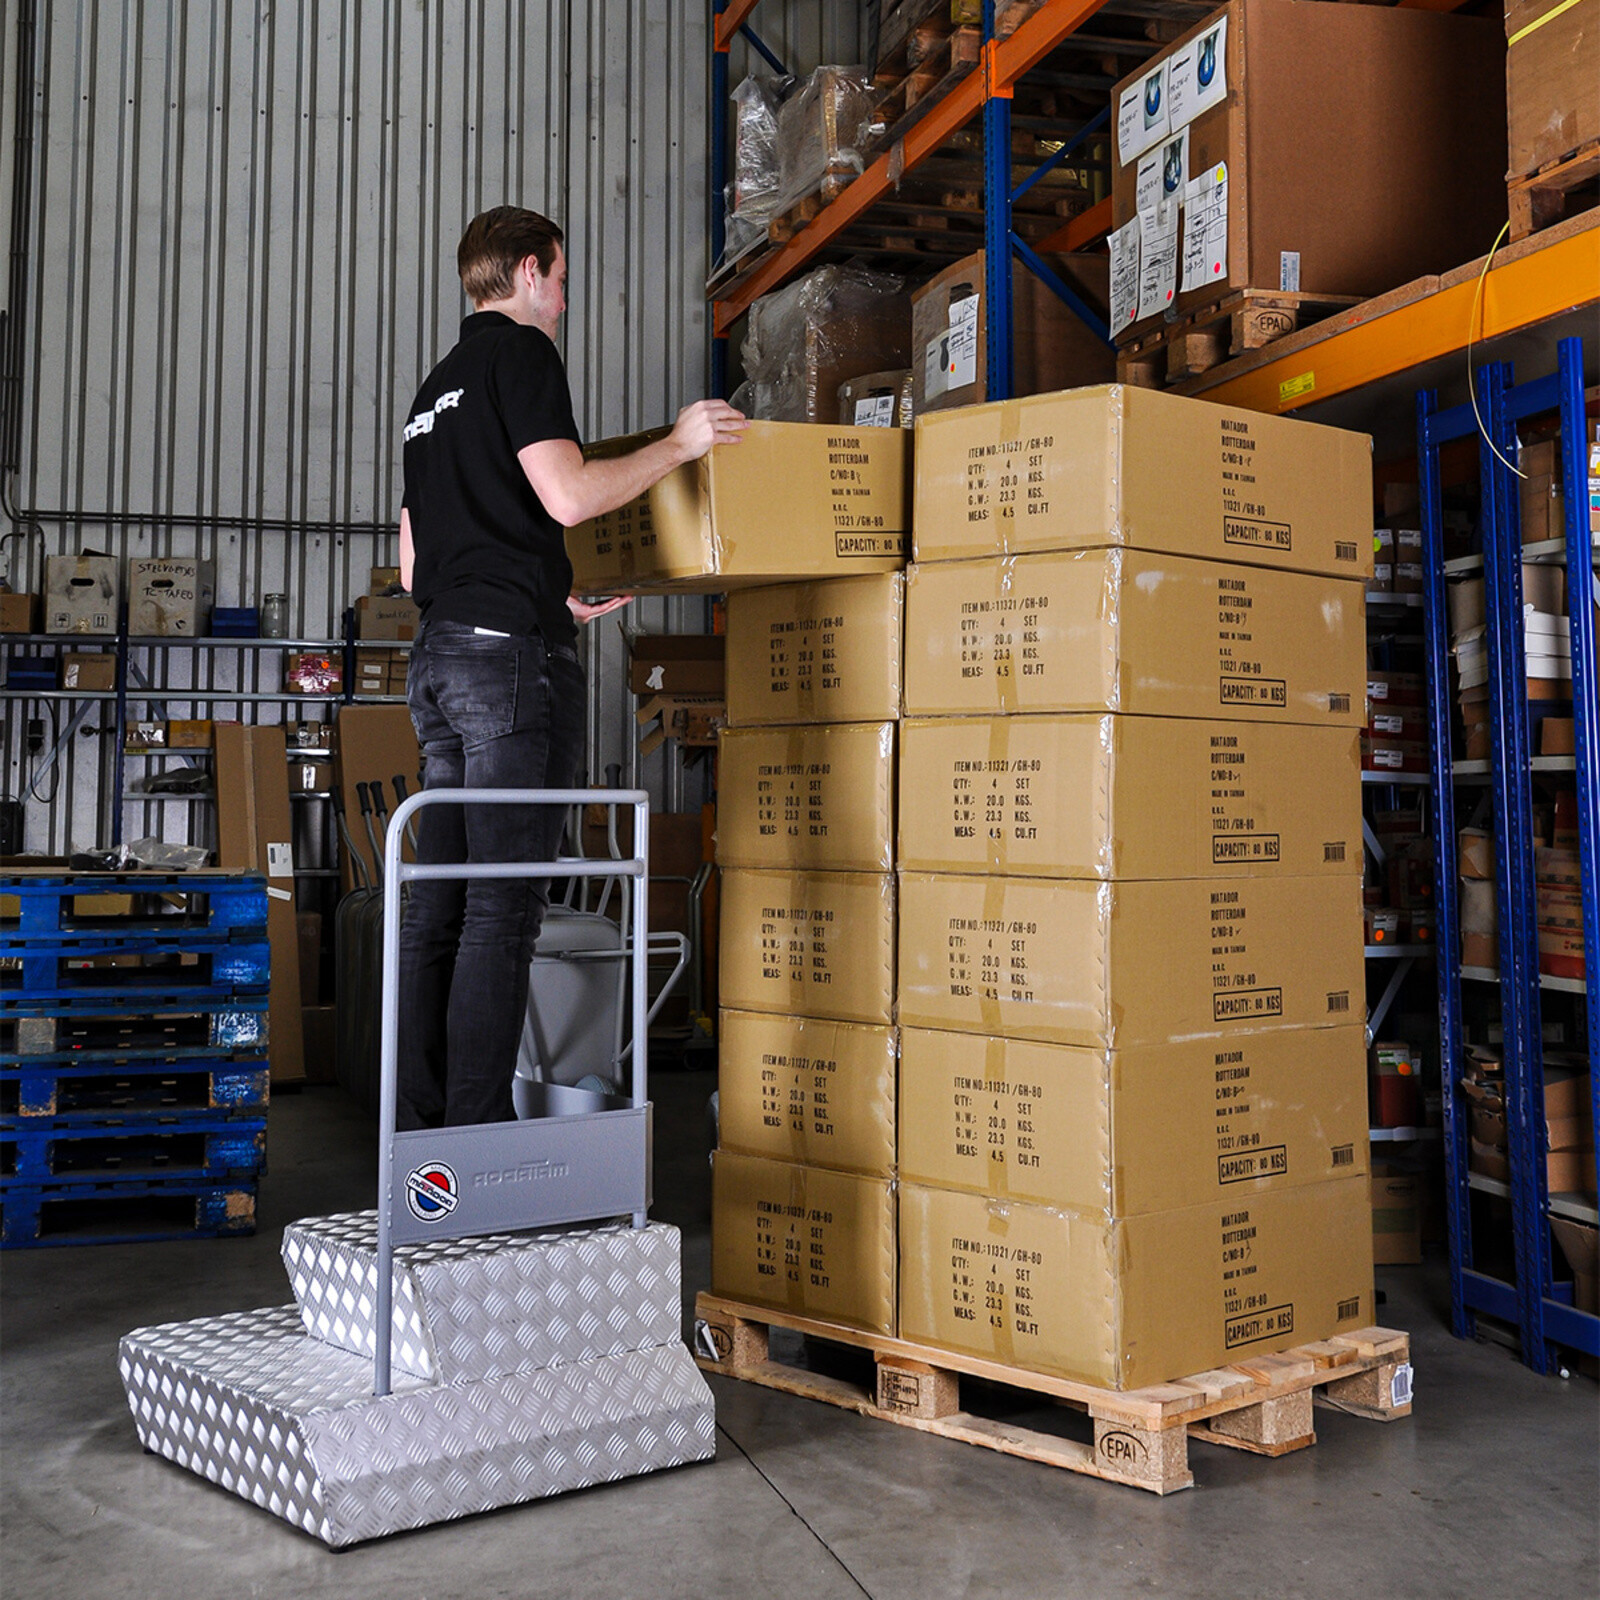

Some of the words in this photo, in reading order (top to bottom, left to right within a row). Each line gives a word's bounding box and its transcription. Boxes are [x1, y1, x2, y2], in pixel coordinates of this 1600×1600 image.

[1261, 316, 1287, 331] EPAL
[1221, 419, 1248, 434] MATADOR
[827, 438, 860, 449] MATADOR
[1221, 435, 1256, 451] ROTTERDAM
[829, 454, 869, 464] ROTTERDAM
[968, 447, 984, 458] ITEM
[1006, 459, 1011, 469] 4
[1029, 454, 1043, 467] SET
[1000, 474, 1018, 487] 20.0
[999, 489, 1016, 502] 23.3
[968, 509, 989, 522] MEAS:
[1002, 506, 1015, 518] 4.5
[1226, 523, 1261, 541] CAPACITY:
[1276, 530, 1289, 545] KGS
[839, 538, 880, 552] CAPACITY:
[884, 539, 893, 550] 80
[1218, 579, 1245, 591] MATADOR
[961, 602, 978, 613] ITEM
[1219, 595, 1252, 608] ROTTERDAM
[1000, 617, 1005, 627] 4
[1023, 615, 1038, 627] SET
[823, 633, 835, 644] SET
[994, 633, 1013, 645] 20.0
[993, 648, 1010, 661] 23.3
[962, 666, 983, 678] MEAS:
[996, 665, 1009, 677] 4.5
[1222, 684, 1257, 700] CAPACITY:
[1271, 687, 1284, 701] KGS
[1210, 736, 1238, 747] MATADOR
[1211, 753, 1245, 764] ROTTERDAM
[954, 761, 971, 772] ITEM
[809, 780, 821, 791] SET
[992, 778, 997, 789] 4
[1015, 778, 1030, 789] SET
[986, 794, 1005, 807] 20.0
[985, 810, 1002, 822] 23.3
[954, 826, 976, 837] MEAS:
[989, 827, 1001, 839] 4.5
[1215, 842, 1250, 857] CAPACITY:
[1264, 842, 1278, 856] KGS
[1210, 891, 1238, 904] MATADOR
[1211, 907, 1246, 921] ROTTERDAM
[949, 918, 966, 930] ITEM
[813, 926, 825, 937] SET
[988, 938, 992, 949] 4
[1011, 939, 1025, 952] SET
[982, 955, 1000, 968] 20.0
[981, 970, 998, 983] 23.3
[950, 984, 973, 997] MEAS:
[985, 988, 998, 1000] 4.5
[1216, 998, 1252, 1015] CAPACITY:
[1266, 995, 1280, 1010] KGS
[1215, 1051, 1243, 1065] MATADOR
[1215, 1067, 1250, 1082] ROTTERDAM
[814, 1076, 827, 1088] SET
[954, 1077, 971, 1089] ITEM
[993, 1099, 998, 1111] 4
[1017, 1102, 1032, 1115] SET
[988, 1116, 1006, 1130] 20.0
[988, 1131, 1005, 1145] 23.3
[955, 1143, 978, 1157] MEAS:
[991, 1149, 1004, 1163] 4.5
[1221, 1158, 1256, 1178] CAPACITY:
[1270, 1153, 1285, 1169] KGS
[1221, 1211, 1249, 1228] MATADOR
[811, 1226, 823, 1239] SET
[1222, 1226, 1257, 1245] ROTTERDAM
[952, 1238, 969, 1251] ITEM
[991, 1264, 996, 1275] 4
[1015, 1268, 1030, 1282] SET
[985, 1280, 1005, 1295] 20.0
[985, 1296, 1003, 1311] 23.3
[954, 1306, 976, 1320] MEAS:
[989, 1314, 1003, 1328] 4.5
[1227, 1320, 1264, 1343] CAPACITY:
[1277, 1312, 1291, 1329] KGS
